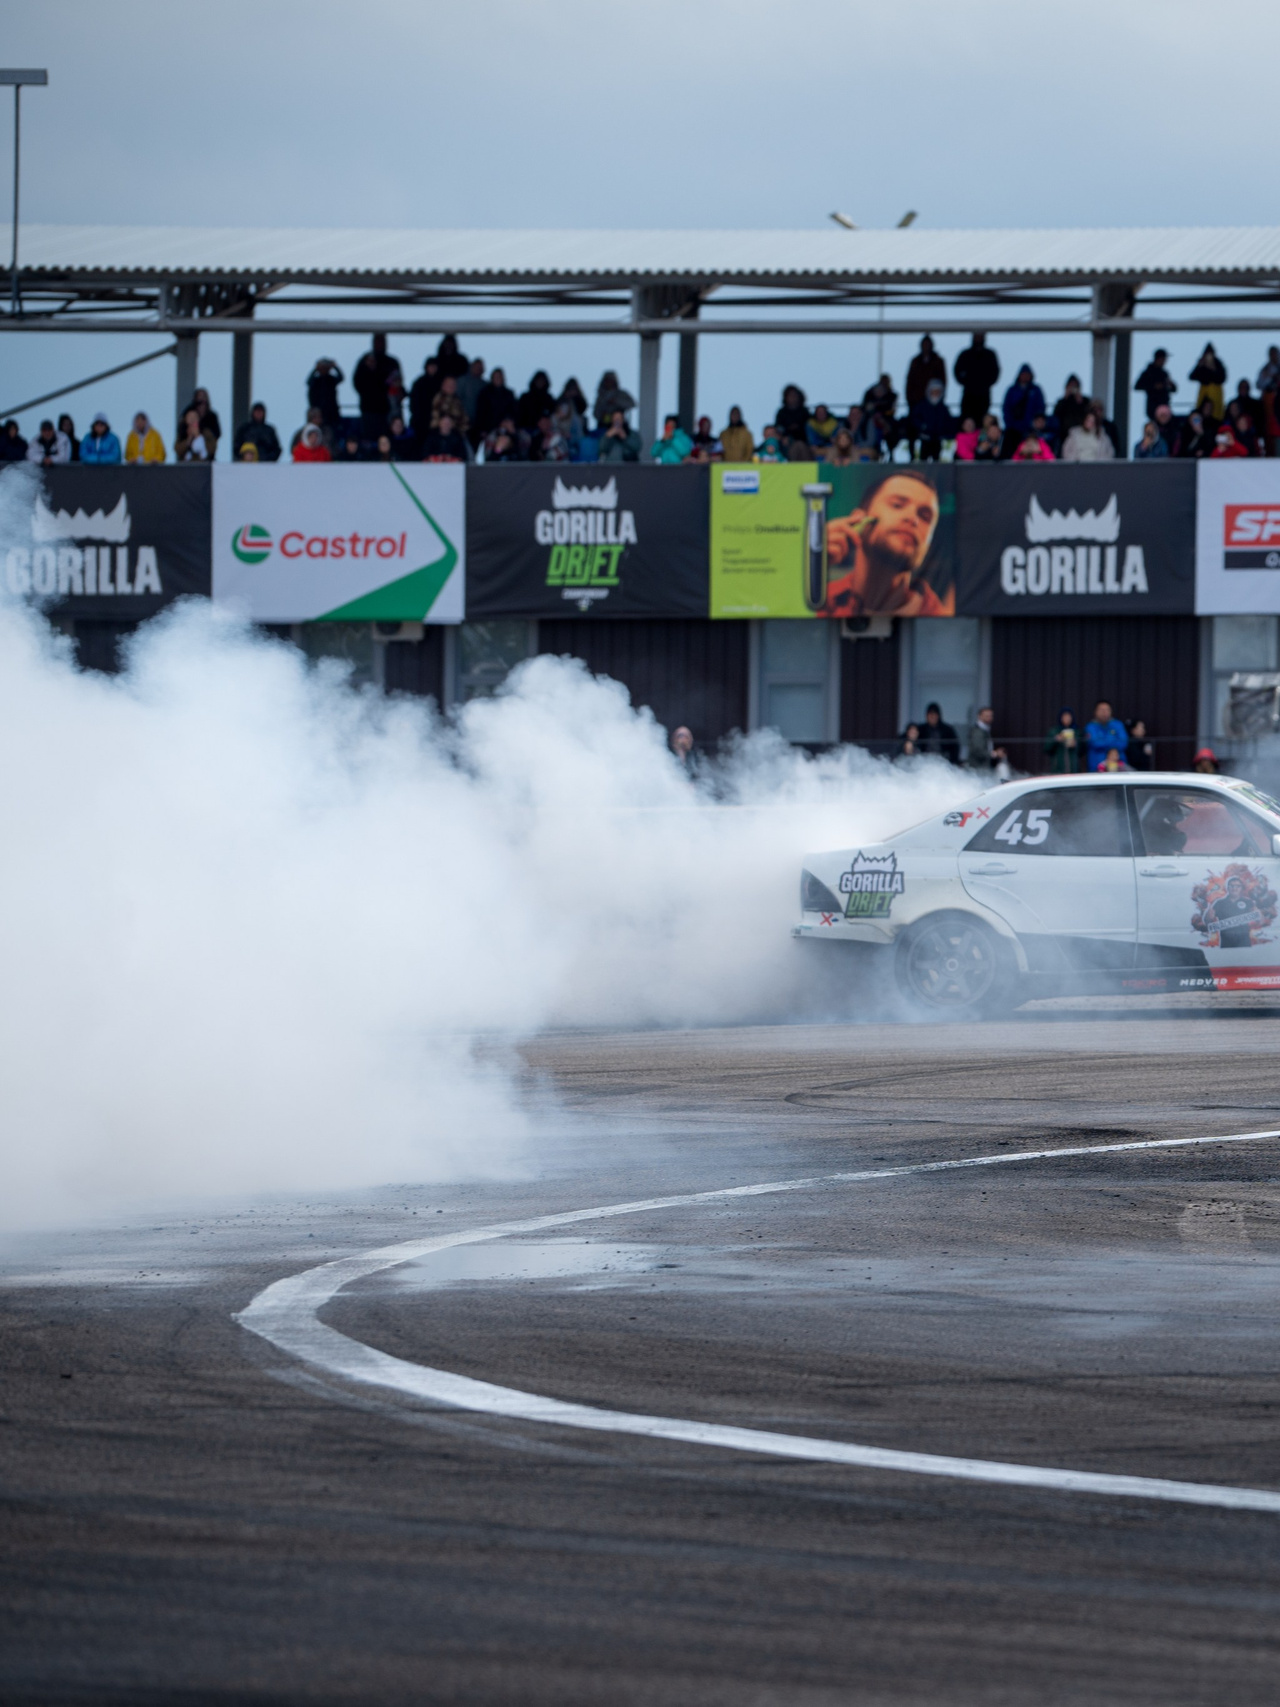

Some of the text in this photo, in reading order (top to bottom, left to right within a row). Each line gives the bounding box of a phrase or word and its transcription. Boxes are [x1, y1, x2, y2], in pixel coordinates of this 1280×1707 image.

[279, 531, 407, 559] Castrol
[534, 509, 638, 545] GORILLA
[5, 545, 163, 596] GORILLA
[545, 544, 625, 586] DRIFT
[1000, 545, 1149, 596] GORILLA
[994, 809, 1052, 845] 45
[841, 872, 903, 892] GORILLA
[846, 892, 894, 916] DRIFT
[1179, 978, 1228, 986] MEDVED
